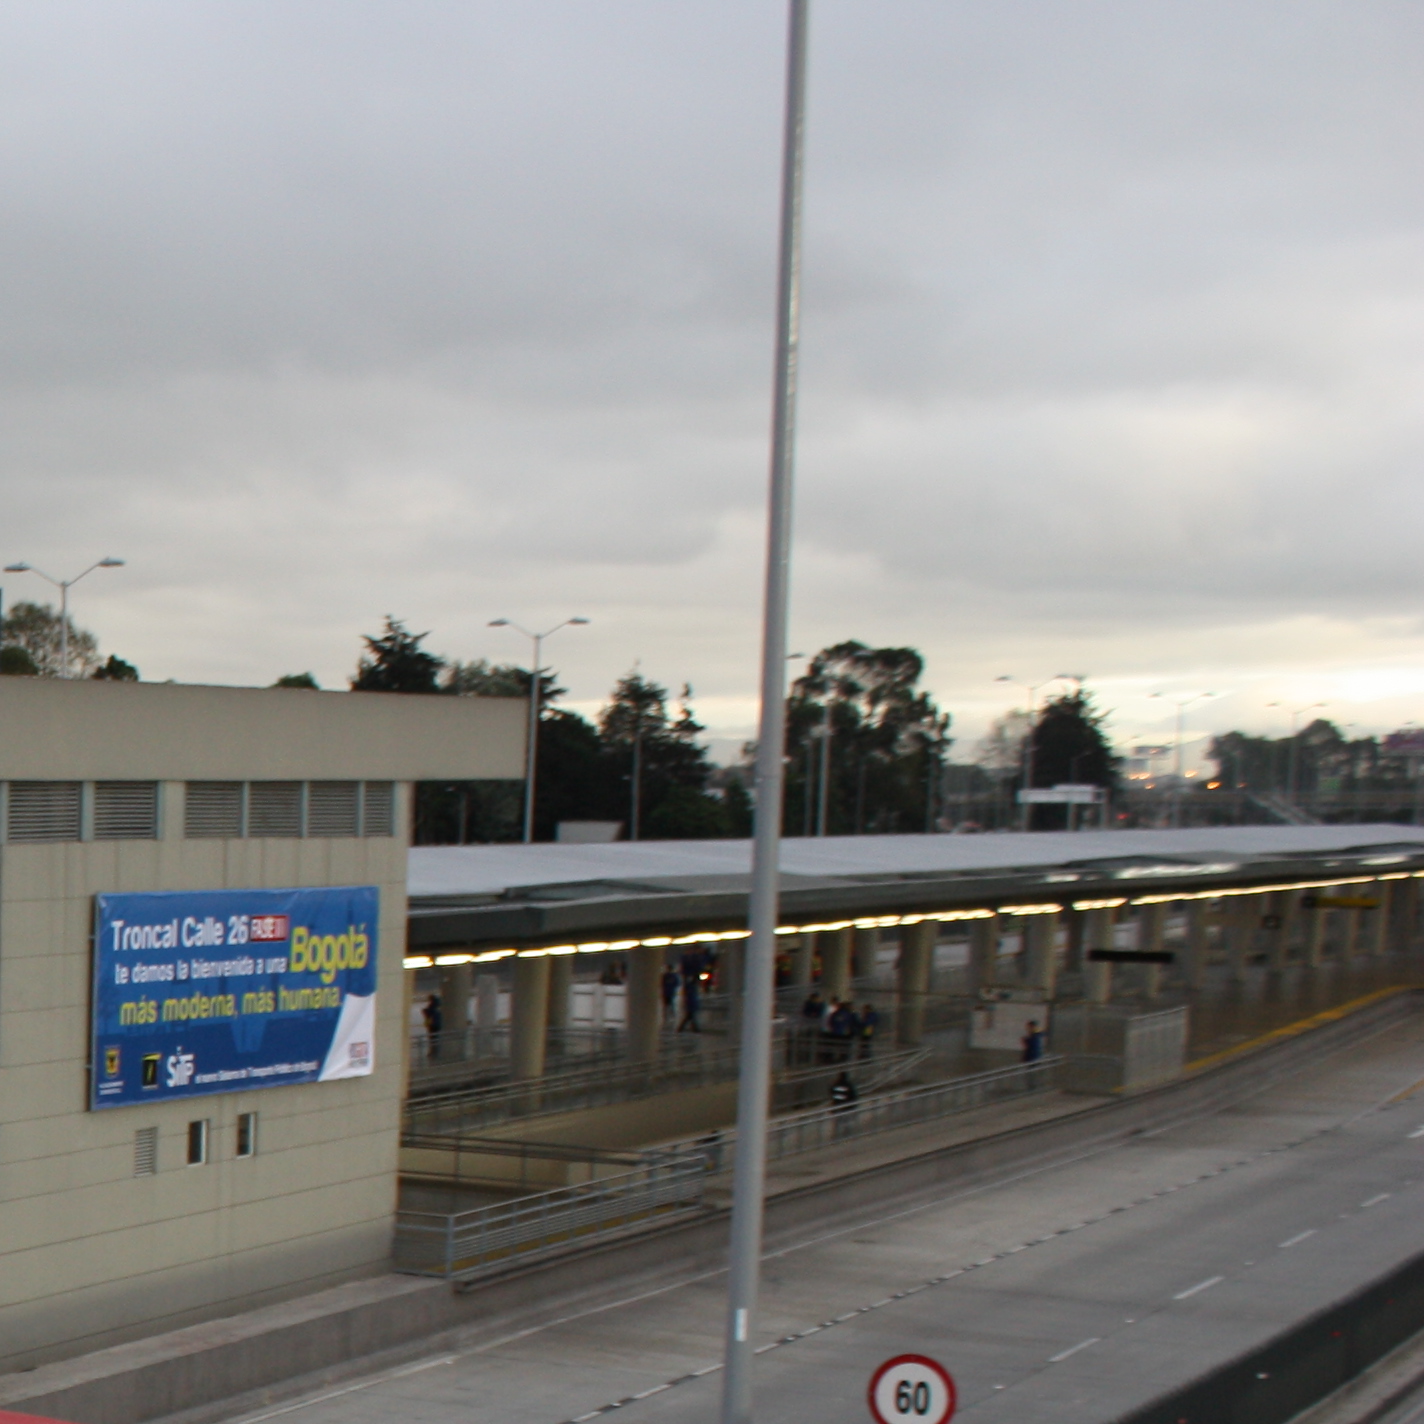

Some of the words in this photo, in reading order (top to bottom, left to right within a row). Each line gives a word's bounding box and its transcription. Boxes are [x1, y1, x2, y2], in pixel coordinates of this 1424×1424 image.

[111, 919, 178, 950] Troncal
[182, 916, 224, 947] Calle
[227, 915, 250, 945] 26
[115, 964, 129, 984] te
[132, 963, 174, 984] damos
[177, 960, 188, 980] la
[191, 957, 254, 979] bienvenida
[266, 957, 287, 973] una
[289, 923, 368, 984] Bogotá
[120, 995, 158, 1025] más
[242, 986, 275, 1014] más
[896, 1380, 929, 1415] 60
